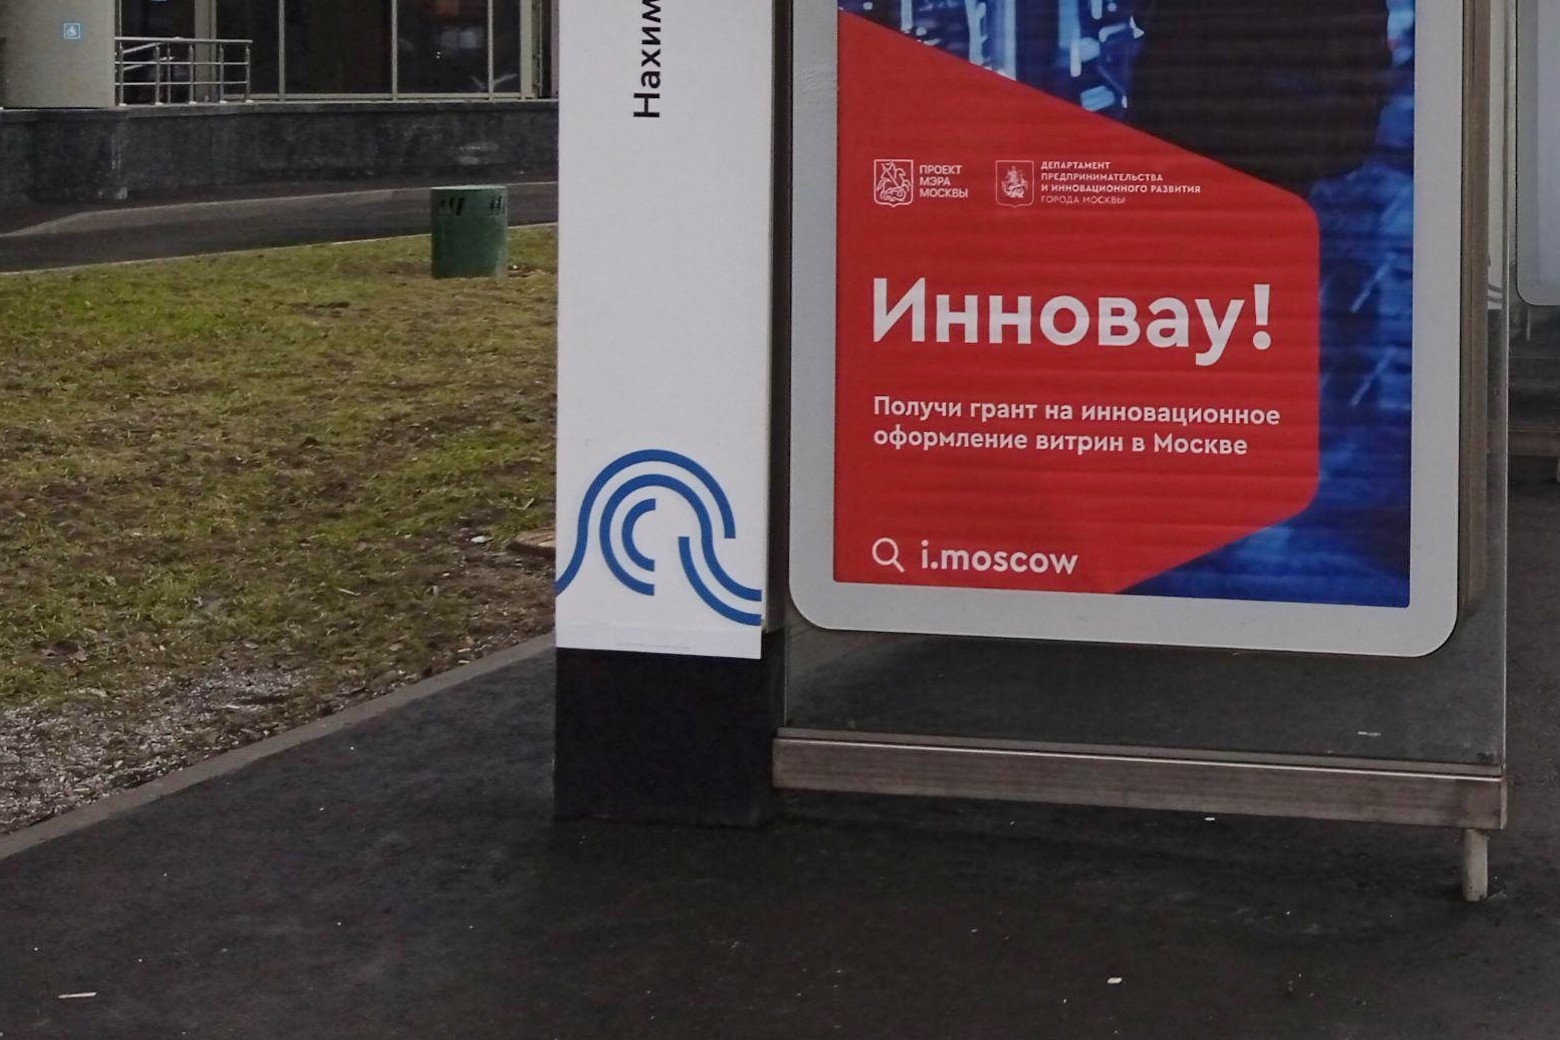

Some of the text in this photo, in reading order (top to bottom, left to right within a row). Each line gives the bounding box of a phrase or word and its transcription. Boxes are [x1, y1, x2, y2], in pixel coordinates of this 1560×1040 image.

[919, 164, 963, 175] ПРОЕКТ
[1041, 161, 1111, 170] ДЕПАРТАМЕНТ
[919, 176, 952, 186] МЭРА
[1041, 173, 1164, 182] ПРЕДПРИНИМАТЕЛЬСТВА
[919, 188, 969, 198] МОСКВЫ
[1041, 184, 1201, 194] И ИННОВАЦИОННОГО РАЗВИТИЯ
[1041, 195, 1127, 204] ГОРОДА МОСКВЫ
[872, 277, 1272, 367] Инновау!
[873, 395, 1281, 427] Получи грант на инновационное
[873, 425, 1248, 455] оформление витрин в Москве
[920, 538, 1079, 576] i.moscow
